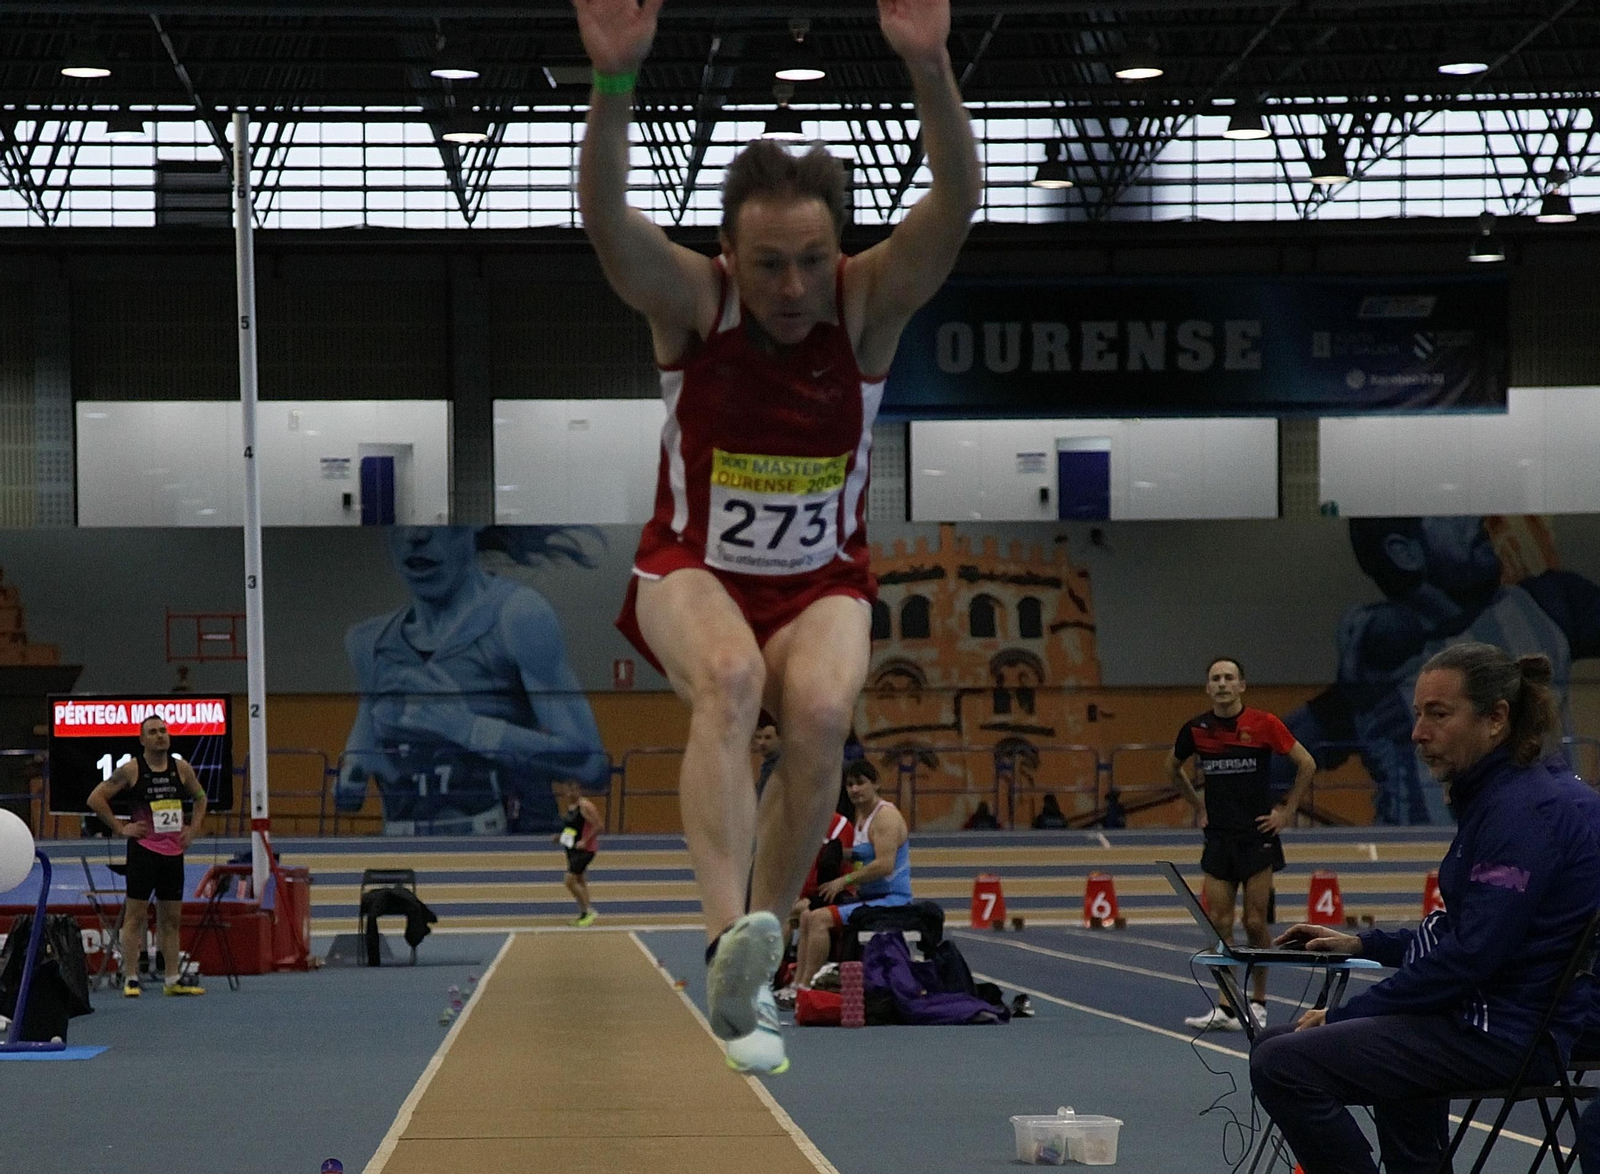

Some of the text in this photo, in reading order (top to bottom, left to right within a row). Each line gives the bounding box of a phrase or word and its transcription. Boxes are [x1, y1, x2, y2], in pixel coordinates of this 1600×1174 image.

[241, 316, 250, 330] 5
[936, 319, 1262, 373] OURENSE
[244, 446, 253, 459] 4
[717, 470, 797, 492] OURENSE
[720, 499, 827, 550] 273
[247, 575, 257, 589] 3
[55, 701, 225, 725] PÉRTEGA MASCULINA
[250, 704, 260, 718] 2
[161, 812, 179, 825] 24
[980, 893, 997, 920] 7
[1091, 892, 1111, 919] 6
[1316, 889, 1336, 916] 4
